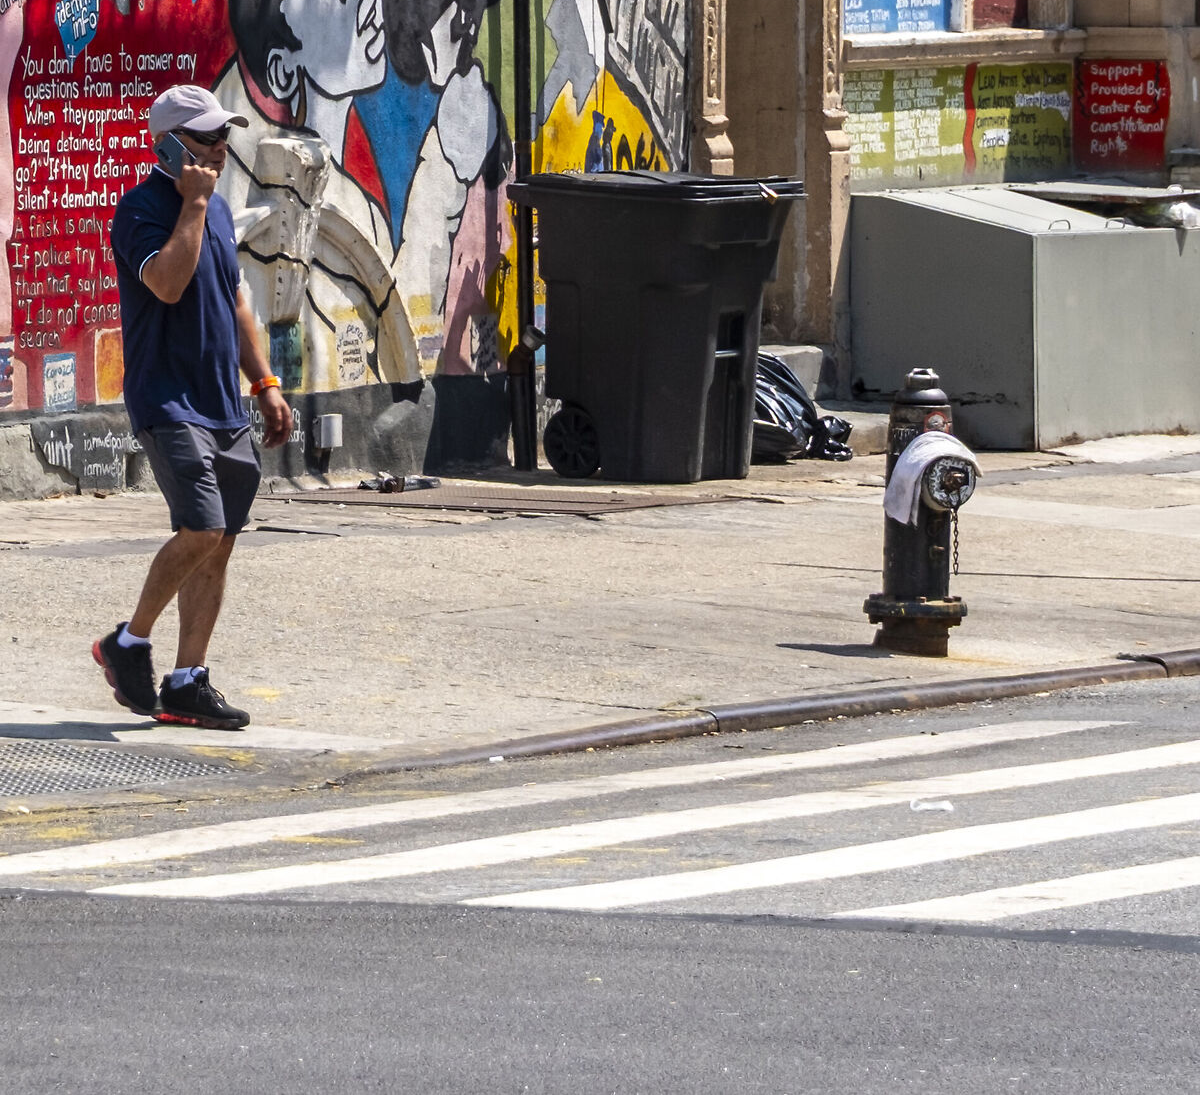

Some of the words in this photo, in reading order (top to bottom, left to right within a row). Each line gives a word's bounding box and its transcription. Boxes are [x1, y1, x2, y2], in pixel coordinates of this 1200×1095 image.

[72, 6, 98, 40] info
[20, 45, 44, 81] You
[48, 43, 76, 75] don't
[84, 45, 113, 73] have
[119, 42, 133, 72] to
[137, 53, 174, 72] answer
[177, 53, 197, 81] any
[1090, 63, 1144, 81] Support
[24, 77, 80, 108] questions
[83, 74, 114, 98] from
[120, 75, 158, 105] police.
[1090, 81, 1144, 97] Provided
[1146, 80, 1167, 101] By:
[24, 102, 56, 125] When
[1090, 100, 1130, 114] Center
[1134, 99, 1154, 114] for
[18, 127, 51, 165] being
[56, 130, 105, 155] detained,
[108, 135, 120, 149] or
[121, 135, 138, 149] am
[139, 129, 148, 148] I
[1090, 135, 1128, 156] Rights
[93, 154, 130, 179] detain
[134, 161, 153, 186] you
[17, 185, 51, 211] silent
[61, 183, 108, 209] demand
[111, 191, 118, 206] a
[14, 216, 25, 240] A
[29, 213, 60, 238] frisk
[65, 213, 75, 234] is
[79, 211, 103, 246] only
[10, 242, 30, 272] If
[34, 242, 71, 278] police
[74, 239, 96, 274] try
[15, 274, 44, 297] than
[78, 278, 97, 301] say
[37, 299, 53, 325] do
[57, 299, 81, 326] not
